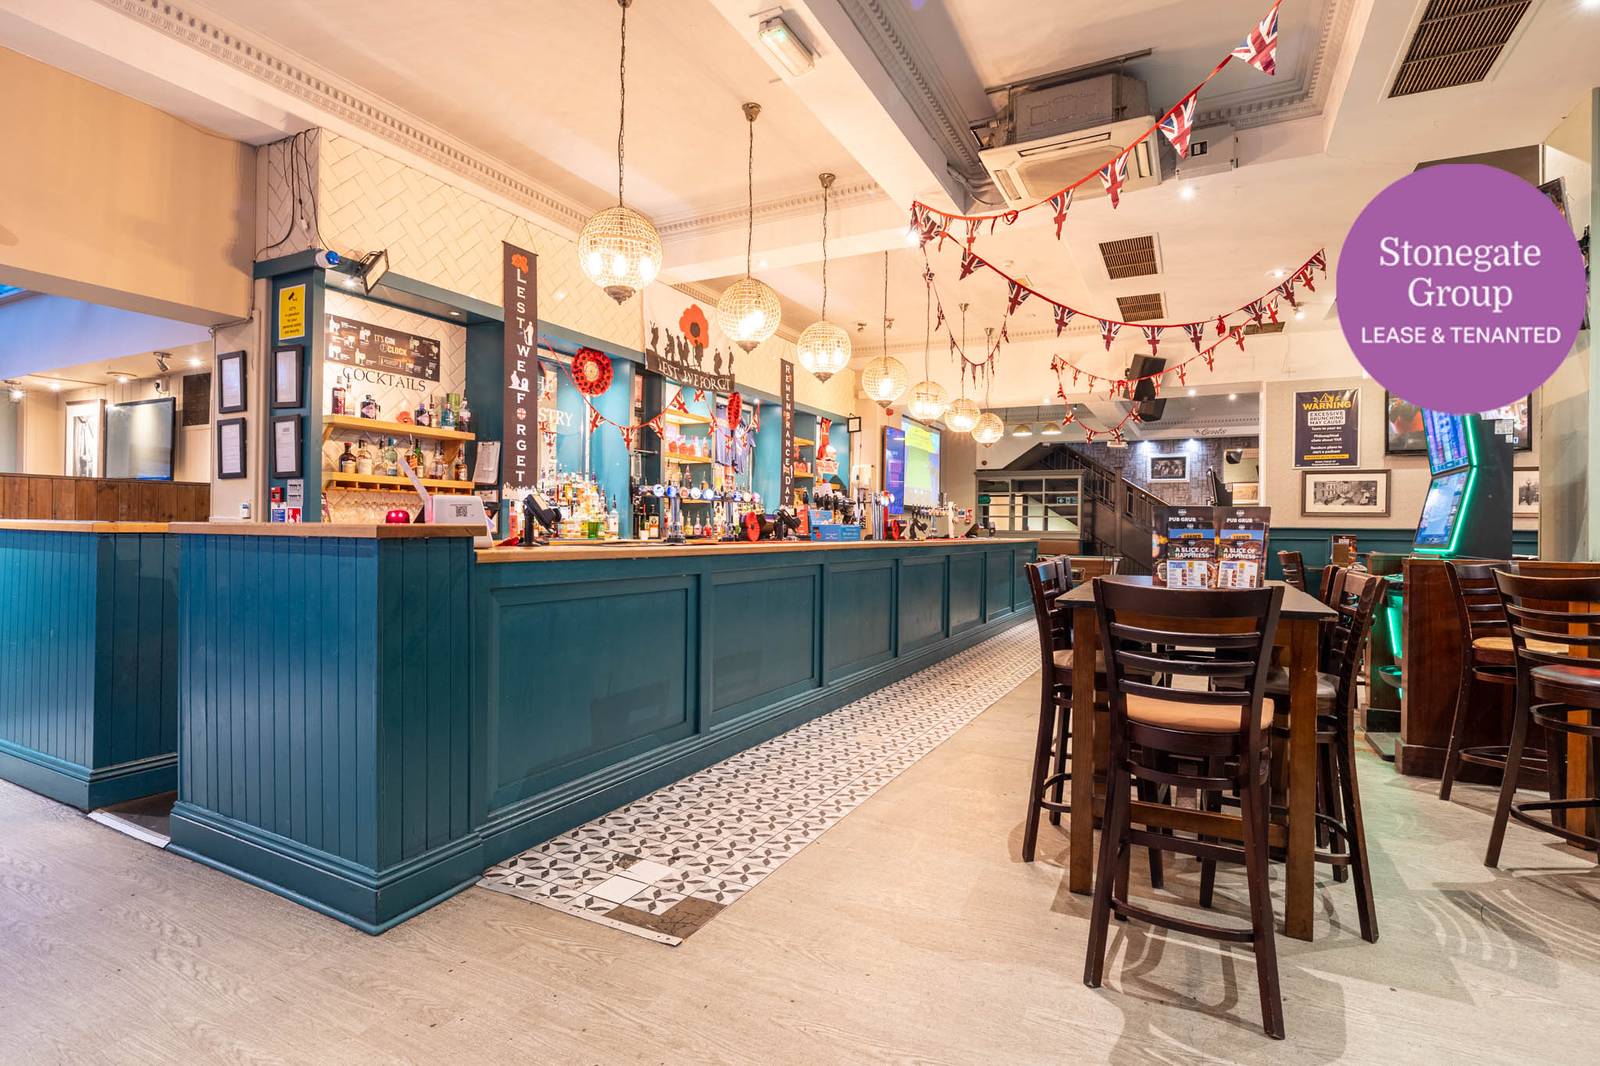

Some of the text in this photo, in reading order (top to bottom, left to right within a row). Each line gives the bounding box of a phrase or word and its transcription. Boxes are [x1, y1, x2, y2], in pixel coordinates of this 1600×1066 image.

[516, 268, 528, 330] LEST
[516, 344, 531, 374] WE
[658, 359, 680, 380] LEST
[683, 370, 700, 387] WE
[342, 367, 426, 392] COCKTAILS
[1302, 401, 1351, 410] WARNING
[784, 364, 793, 503] REMEMBRANCE DAY
